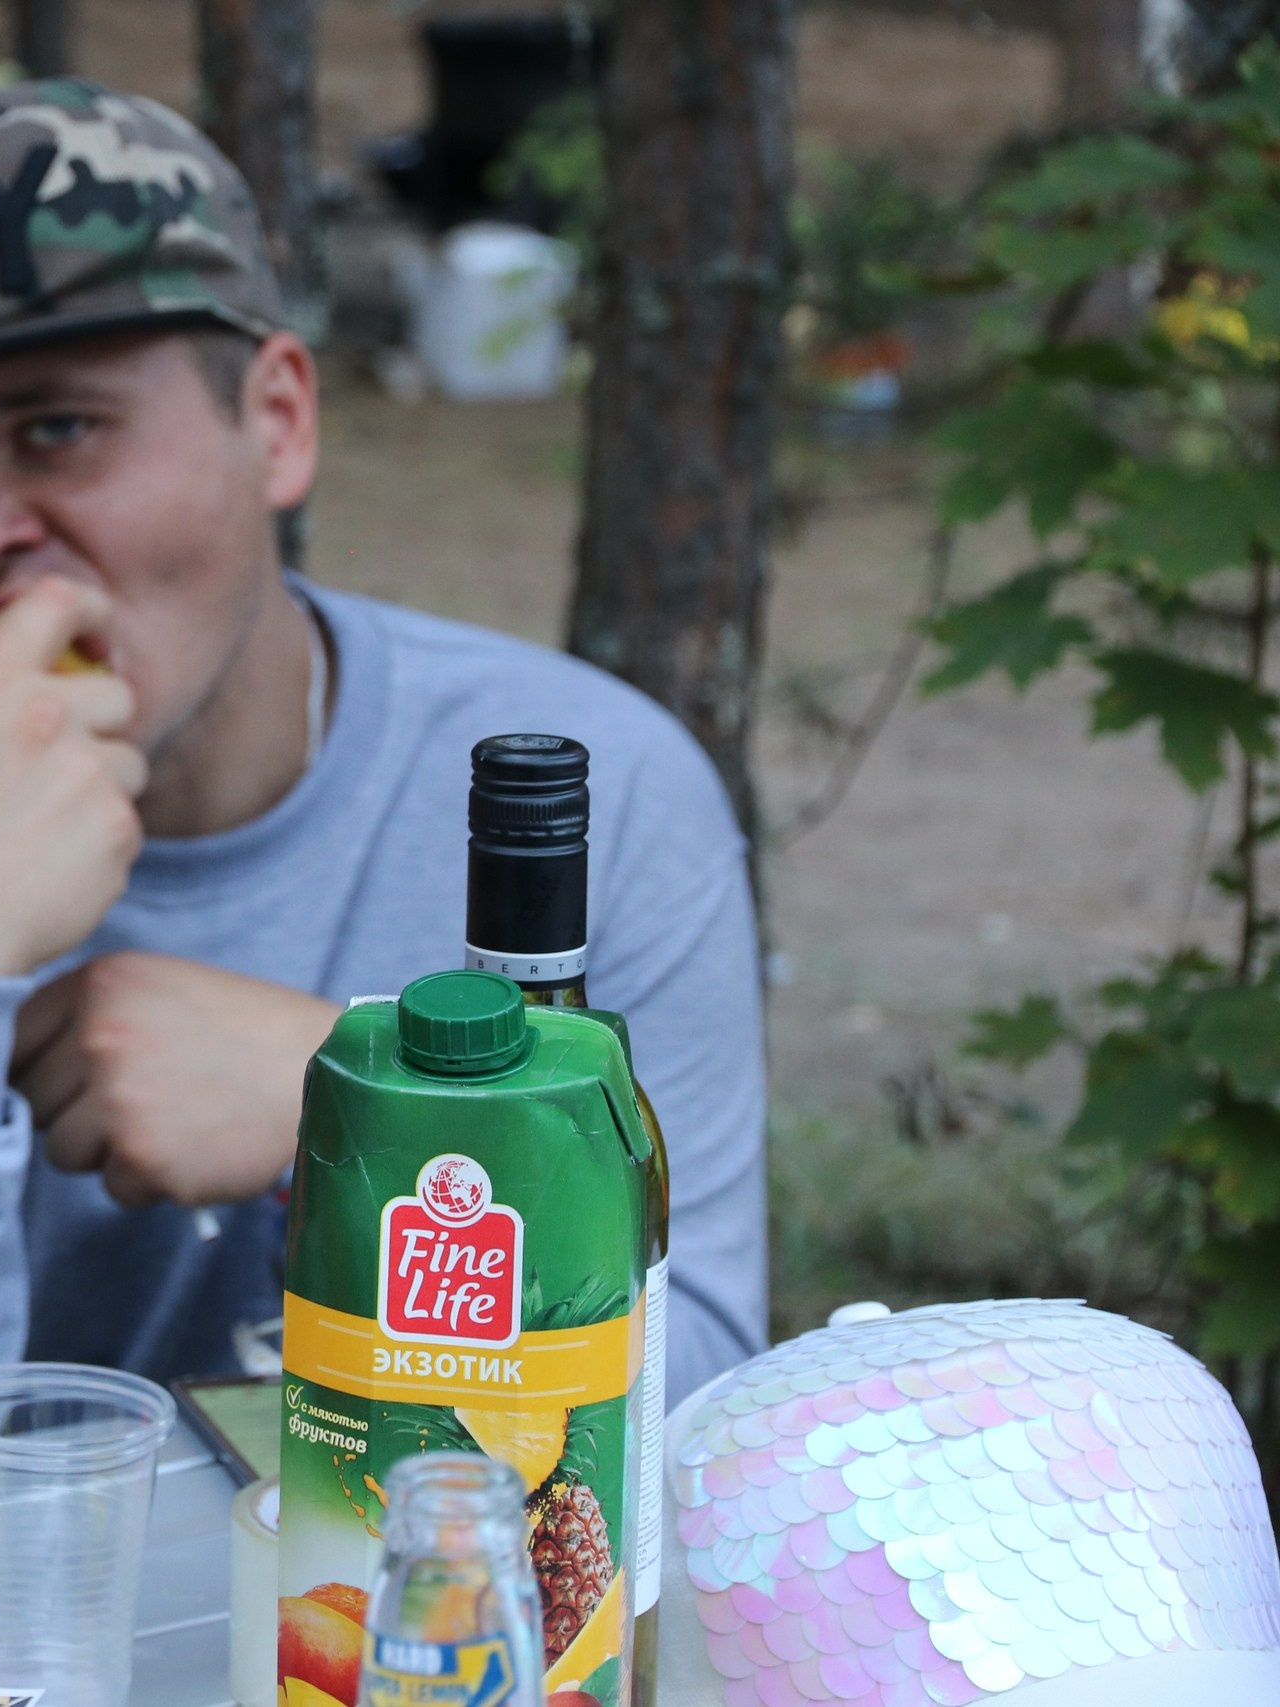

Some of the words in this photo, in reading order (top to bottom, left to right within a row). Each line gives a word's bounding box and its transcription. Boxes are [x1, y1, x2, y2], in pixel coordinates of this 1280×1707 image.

[398, 1228, 506, 1278] Fine
[403, 1269, 496, 1332] Life
[372, 1347, 523, 1385] ЭКЗОТИК
[288, 1413, 368, 1454] фруктов
[308, 1405, 369, 1432] мякотью
